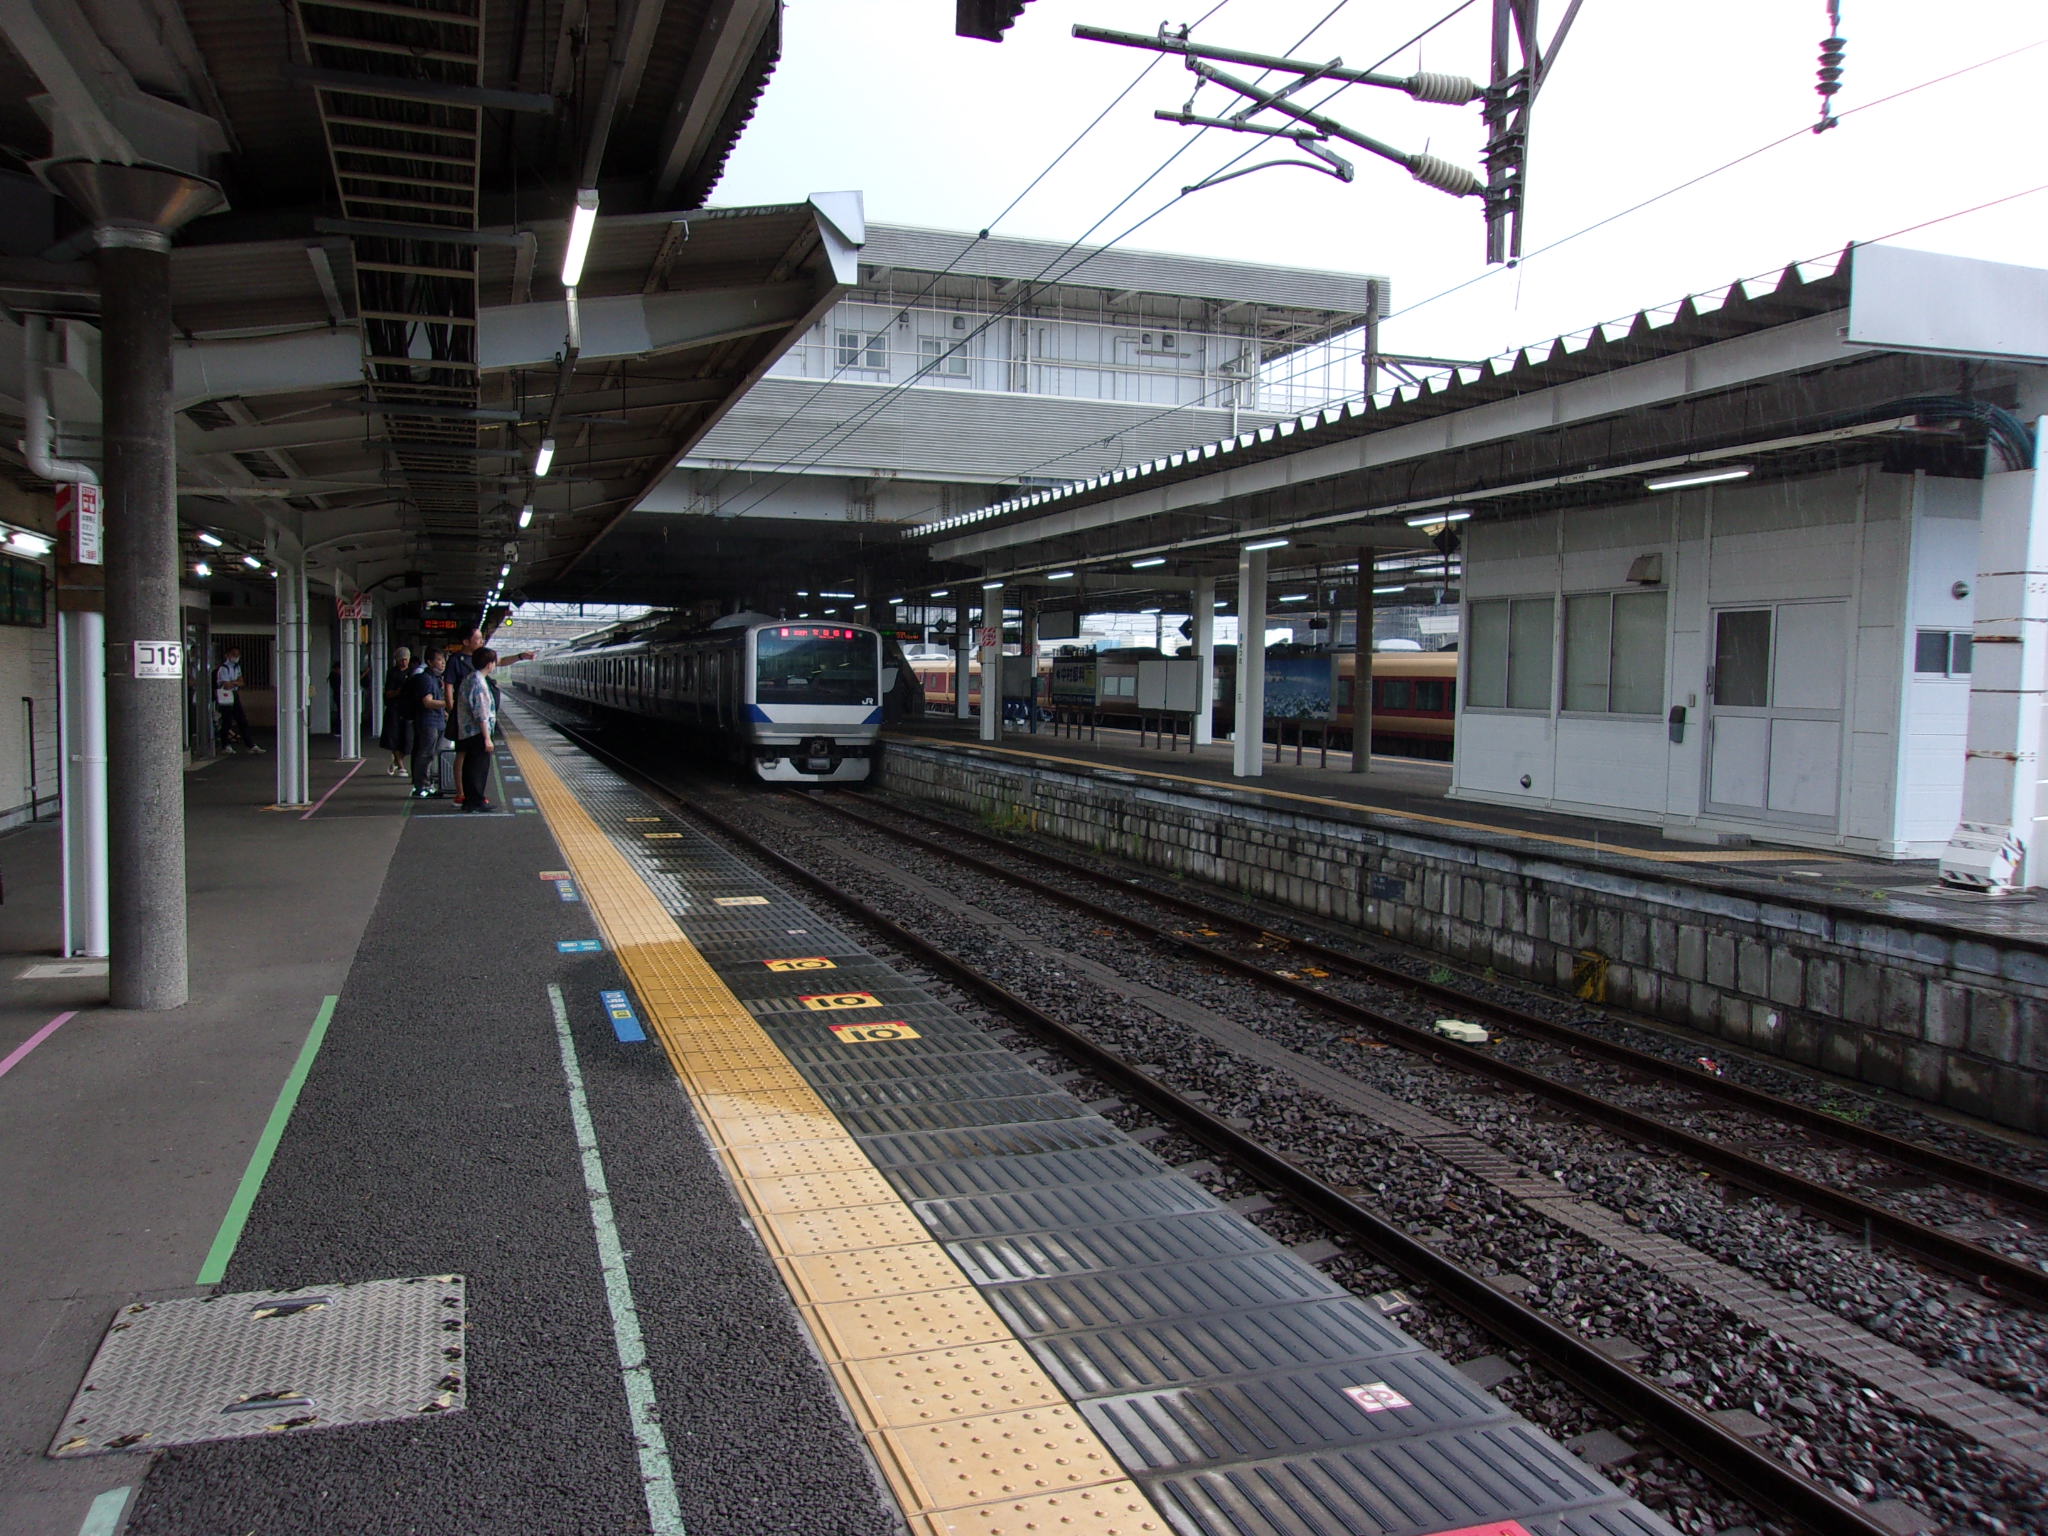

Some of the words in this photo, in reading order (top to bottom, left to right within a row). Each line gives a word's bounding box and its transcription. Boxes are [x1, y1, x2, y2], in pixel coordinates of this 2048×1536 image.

[861, 697, 874, 705] JR
[776, 960, 828, 970] 10
[815, 996, 867, 1008] 10
[850, 1028, 902, 1041] 10
